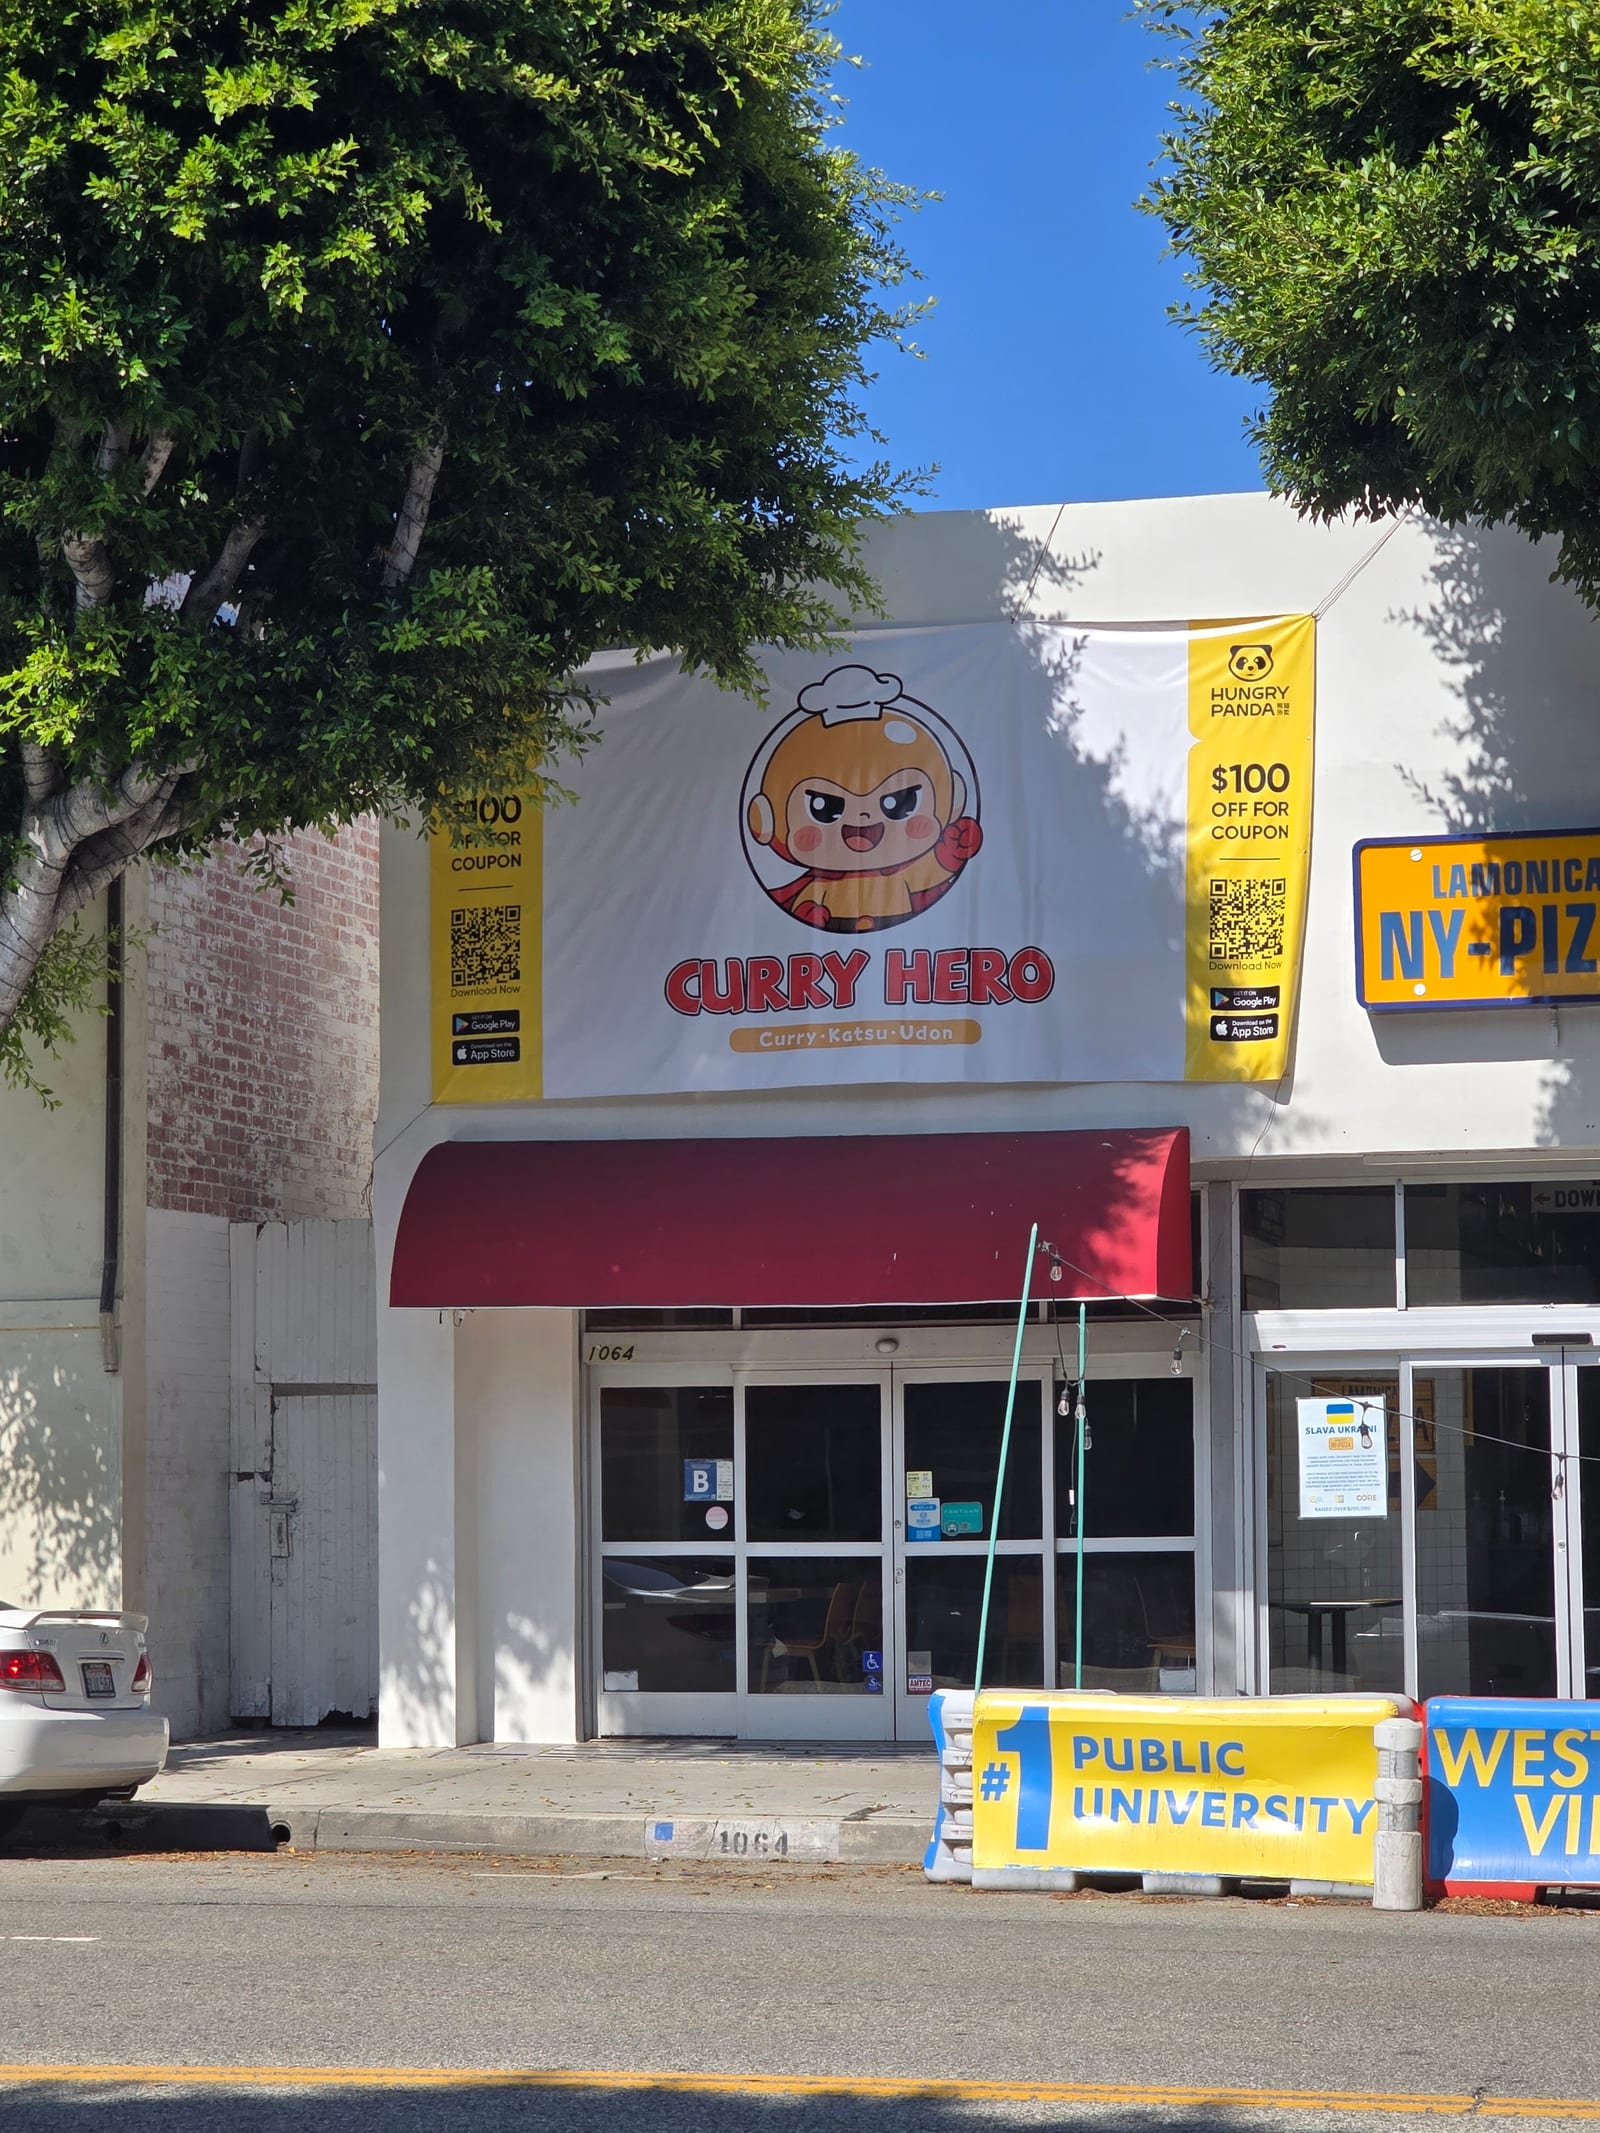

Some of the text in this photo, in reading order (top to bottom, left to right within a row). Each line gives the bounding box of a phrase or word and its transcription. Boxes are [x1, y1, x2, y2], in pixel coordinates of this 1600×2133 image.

[1211, 686, 1290, 701] HUNGRY
[1211, 703, 1275, 717] PANDA
[1211, 763, 1290, 794] $100
[1211, 801, 1289, 817] OFF FOR
[1211, 825, 1289, 839] COUPON
[451, 854, 521, 871] COUPON
[1209, 961, 1283, 970] Download Now
[664, 946, 1055, 1016] CURRY HERO
[451, 985, 520, 997] Download Now
[1233, 996, 1276, 1008] Google Play
[471, 1019, 516, 1031] Google Play
[1231, 1026, 1274, 1038] App Store
[470, 1049, 516, 1060] App Store
[588, 1345, 635, 1361] 1064
[1305, 1425, 1377, 1435] SLAVA UKRANI
[693, 1470, 709, 1493] B
[1072, 1736, 1246, 1776] PUBLIC
[1073, 1787, 1375, 1835] UNIVERSITY
[720, 1831, 789, 1856] 1064
